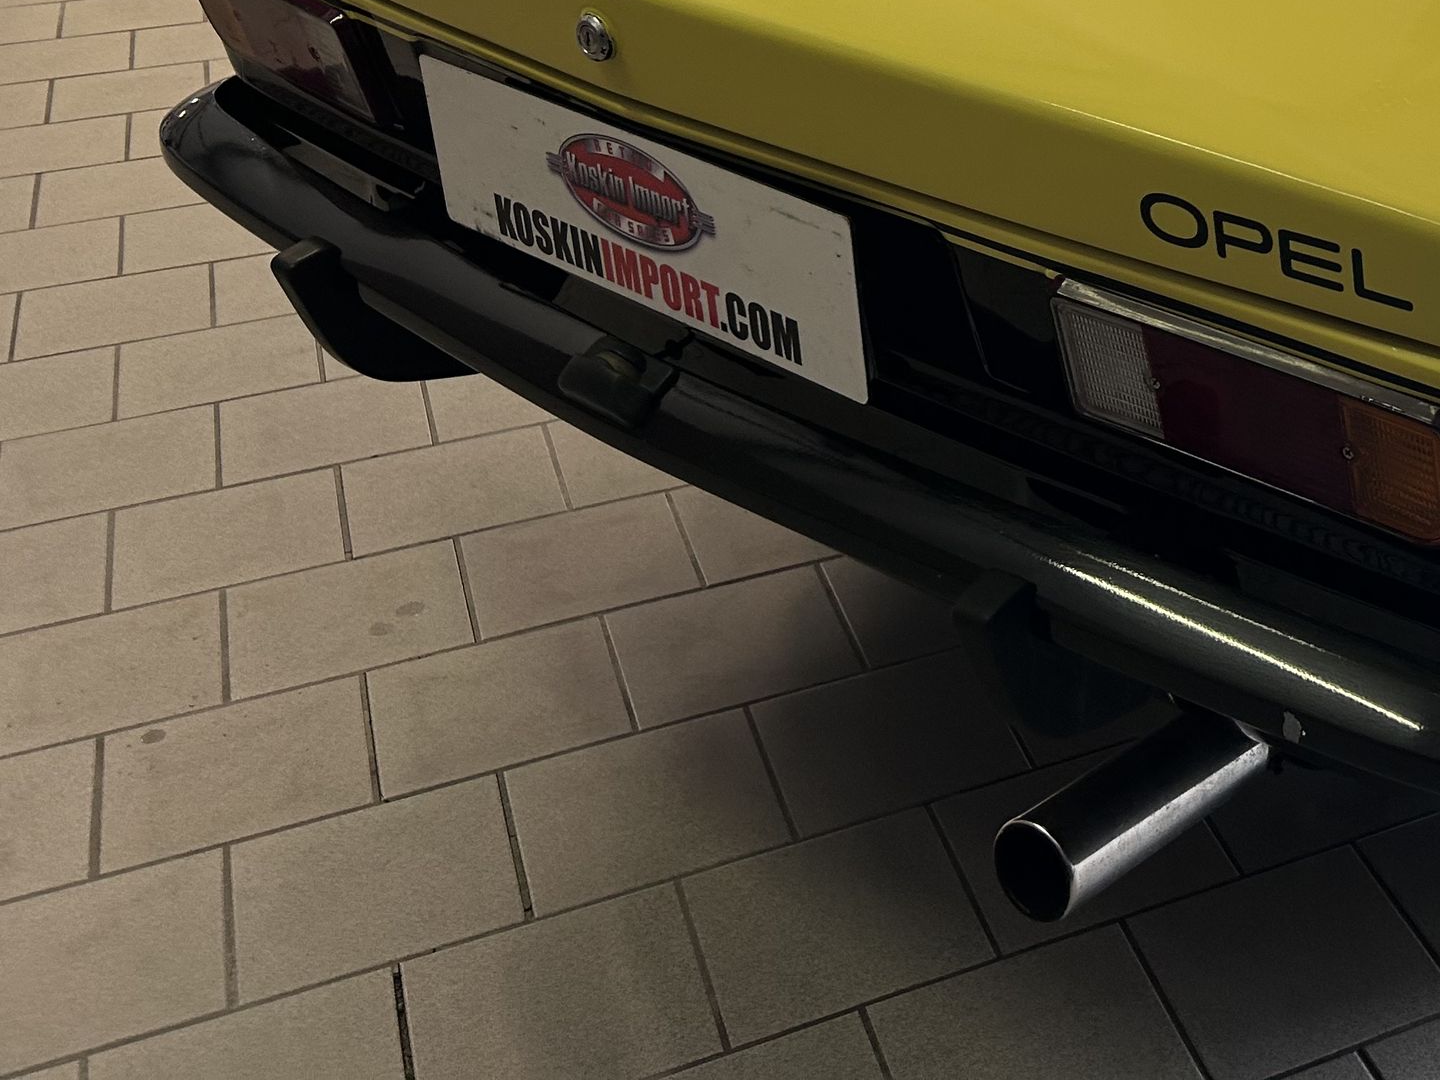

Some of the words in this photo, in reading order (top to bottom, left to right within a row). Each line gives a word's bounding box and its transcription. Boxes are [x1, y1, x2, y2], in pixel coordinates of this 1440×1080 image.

[565, 151, 628, 206] Koskin
[628, 176, 690, 225] Import
[494, 192, 803, 366] KOSKINIMPORT.COM
[1140, 193, 1413, 312] OPEL
